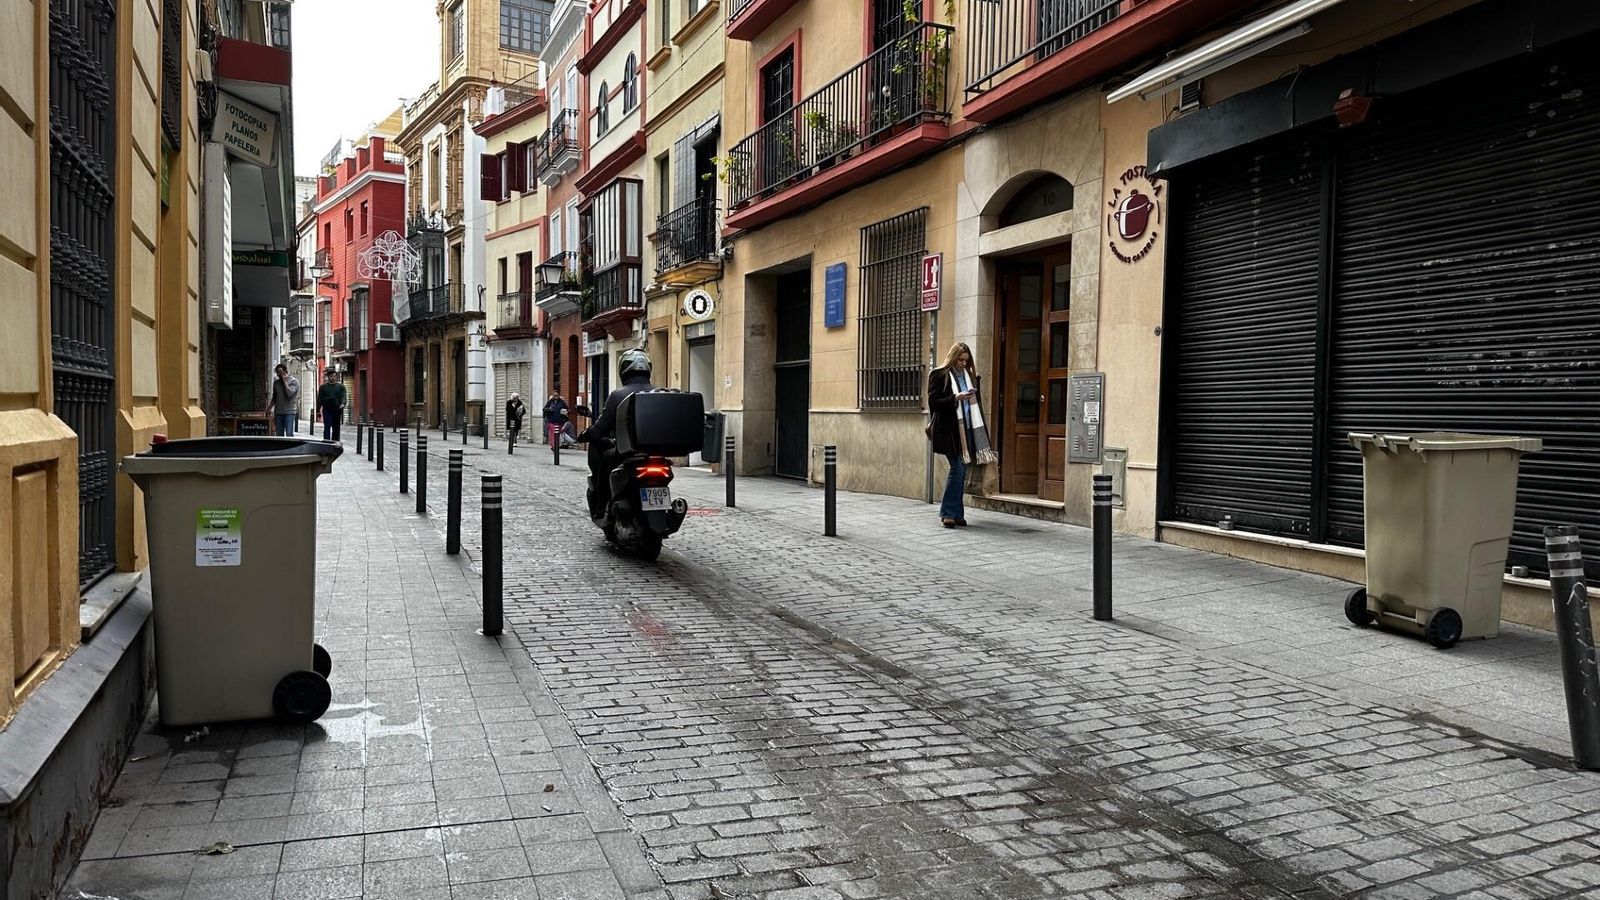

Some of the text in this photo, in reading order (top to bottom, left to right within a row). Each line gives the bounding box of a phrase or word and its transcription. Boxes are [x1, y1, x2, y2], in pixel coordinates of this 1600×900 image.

[225, 103, 268, 132] FOTOCOPIAS
[231, 120, 258, 141] PLANOS
[1108, 188, 1121, 208] LA
[647, 489, 668, 498] 7905
[648, 497, 664, 506] LTV
